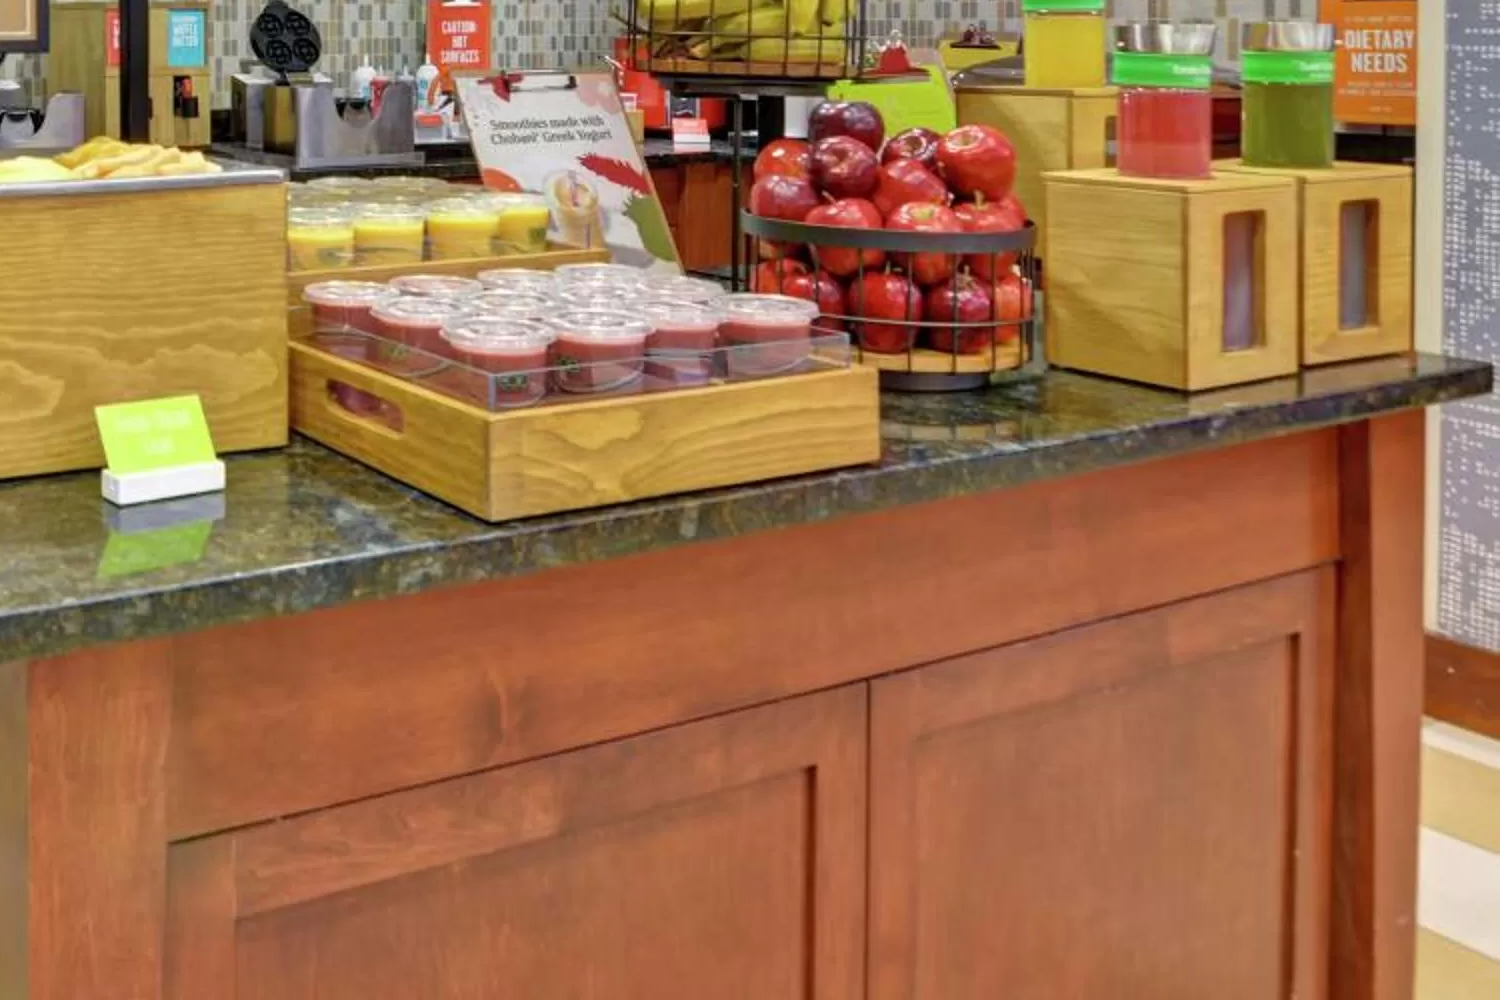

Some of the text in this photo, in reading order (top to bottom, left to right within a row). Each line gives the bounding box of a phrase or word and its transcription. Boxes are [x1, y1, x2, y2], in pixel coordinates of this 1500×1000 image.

[1345, 29, 1414, 50] DIETARY
[1350, 52, 1409, 73] NEEDS
[490, 114, 604, 130] Smoothies made with
[543, 130, 575, 142] Greek
[577, 128, 613, 143] Yogurt
